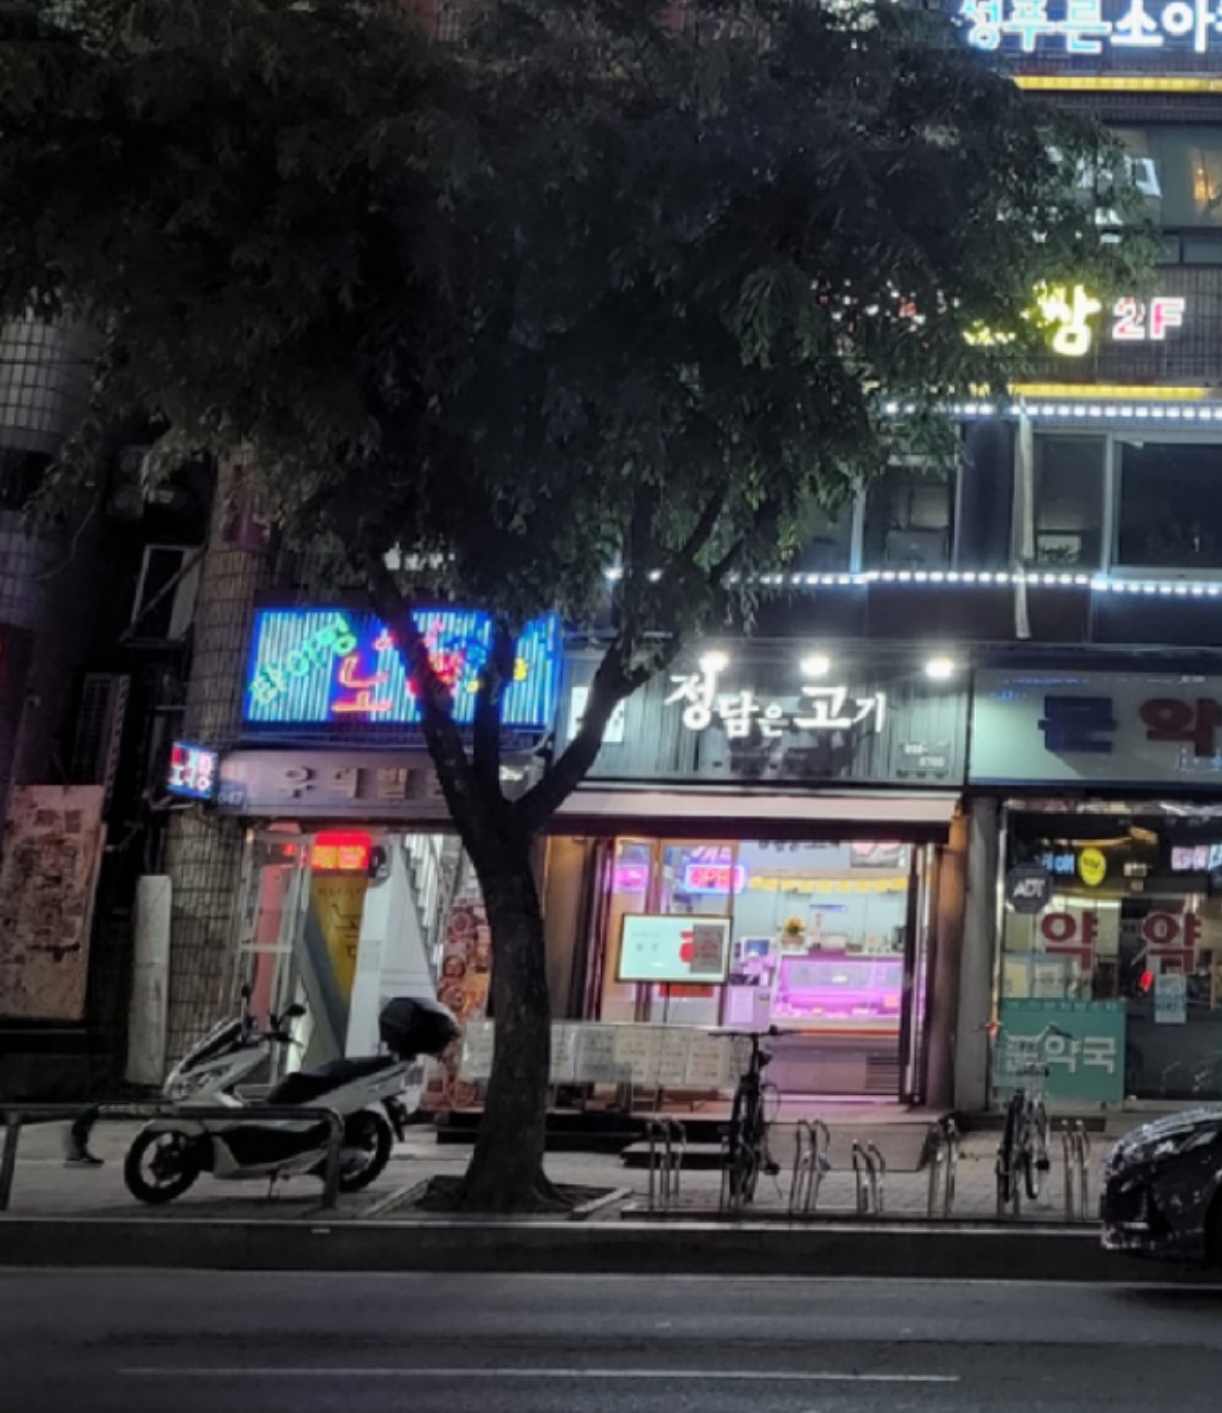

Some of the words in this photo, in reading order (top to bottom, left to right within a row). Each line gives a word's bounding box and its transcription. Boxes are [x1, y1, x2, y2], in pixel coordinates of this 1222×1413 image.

[1112, 296, 1186, 341] 2F
[1012, 878, 1048, 899] ADT
[1040, 911, 1099, 975] 약
[1142, 911, 1202, 975] 약
